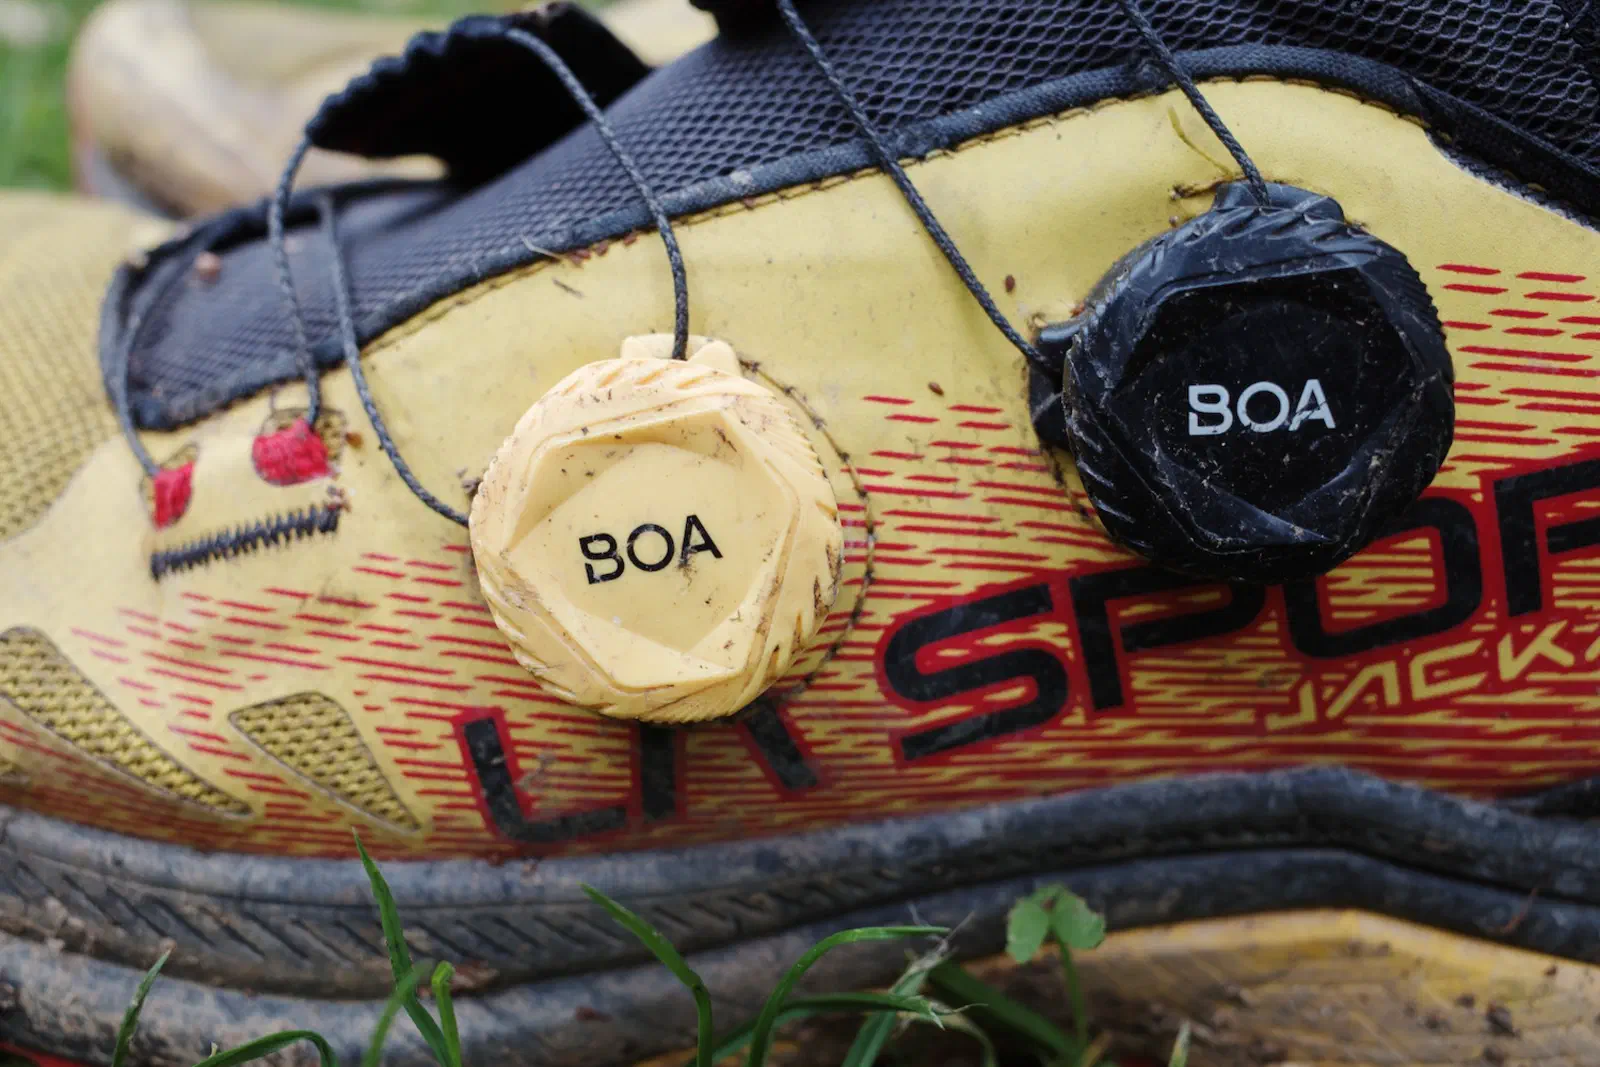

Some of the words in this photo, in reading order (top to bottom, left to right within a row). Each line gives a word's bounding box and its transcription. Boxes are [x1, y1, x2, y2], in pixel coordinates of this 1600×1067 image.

[1188, 378, 1336, 436] BOA
[579, 514, 723, 584] BOA
[1265, 620, 1600, 731] JACK
